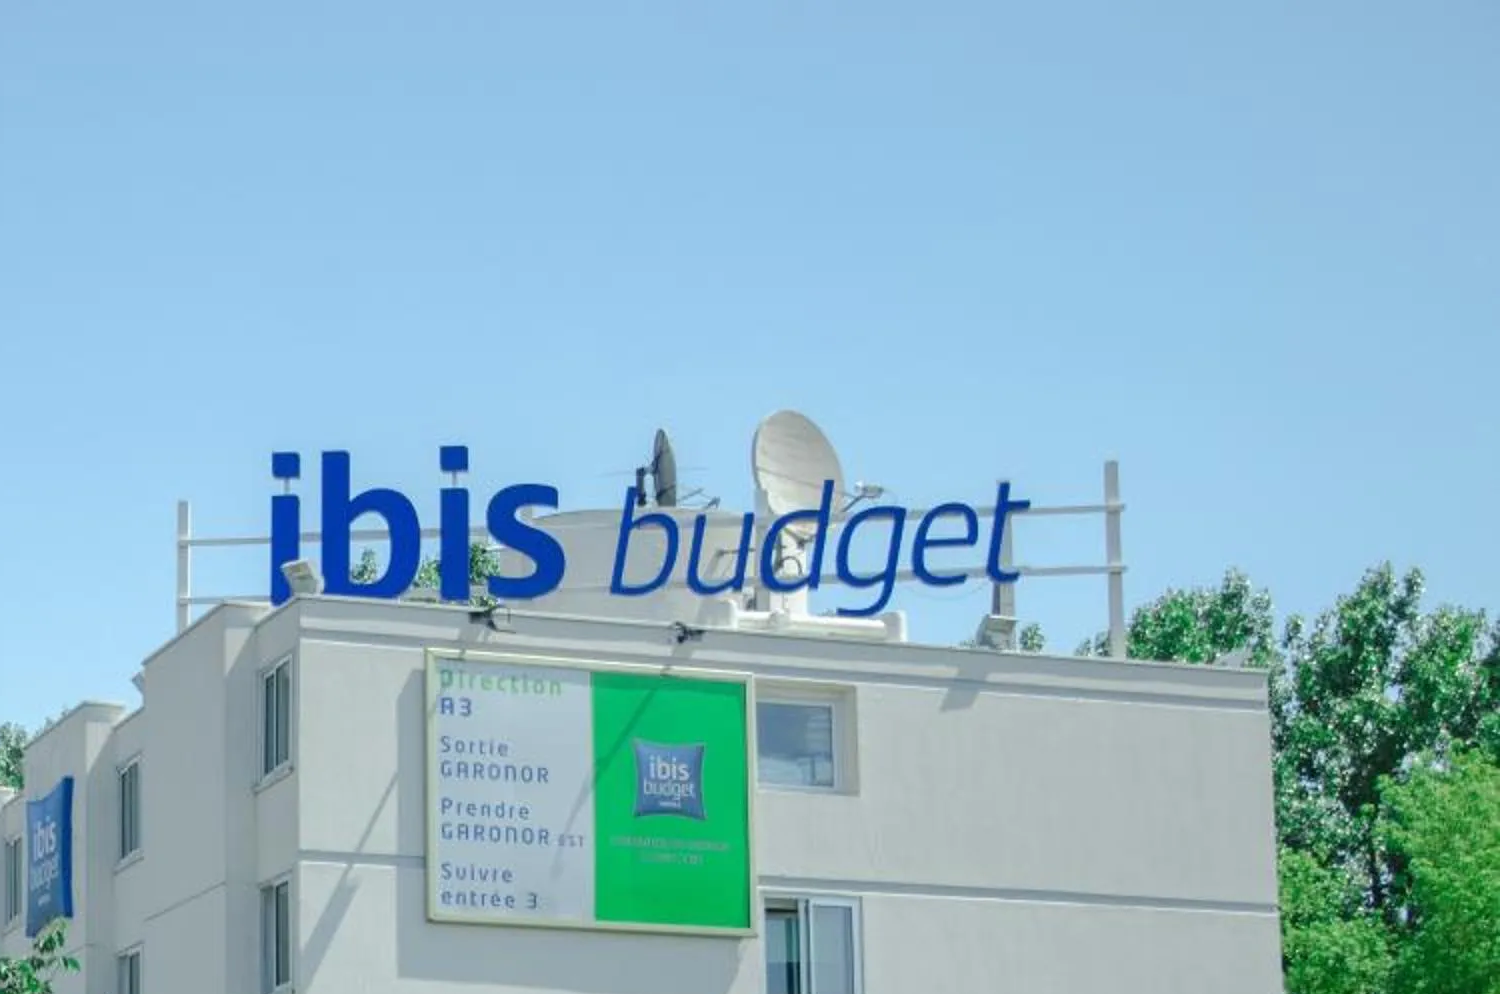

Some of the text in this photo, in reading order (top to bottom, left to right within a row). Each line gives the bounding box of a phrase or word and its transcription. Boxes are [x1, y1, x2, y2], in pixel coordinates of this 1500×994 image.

[271, 445, 1030, 617] ibis budget
[440, 669, 563, 696] Direction
[440, 697, 473, 717] A3
[440, 735, 509, 757] Sortie
[649, 754, 690, 781] ibis
[440, 798, 531, 820] Prendre
[440, 862, 515, 883] Suivre
[526, 891, 540, 910] 3
